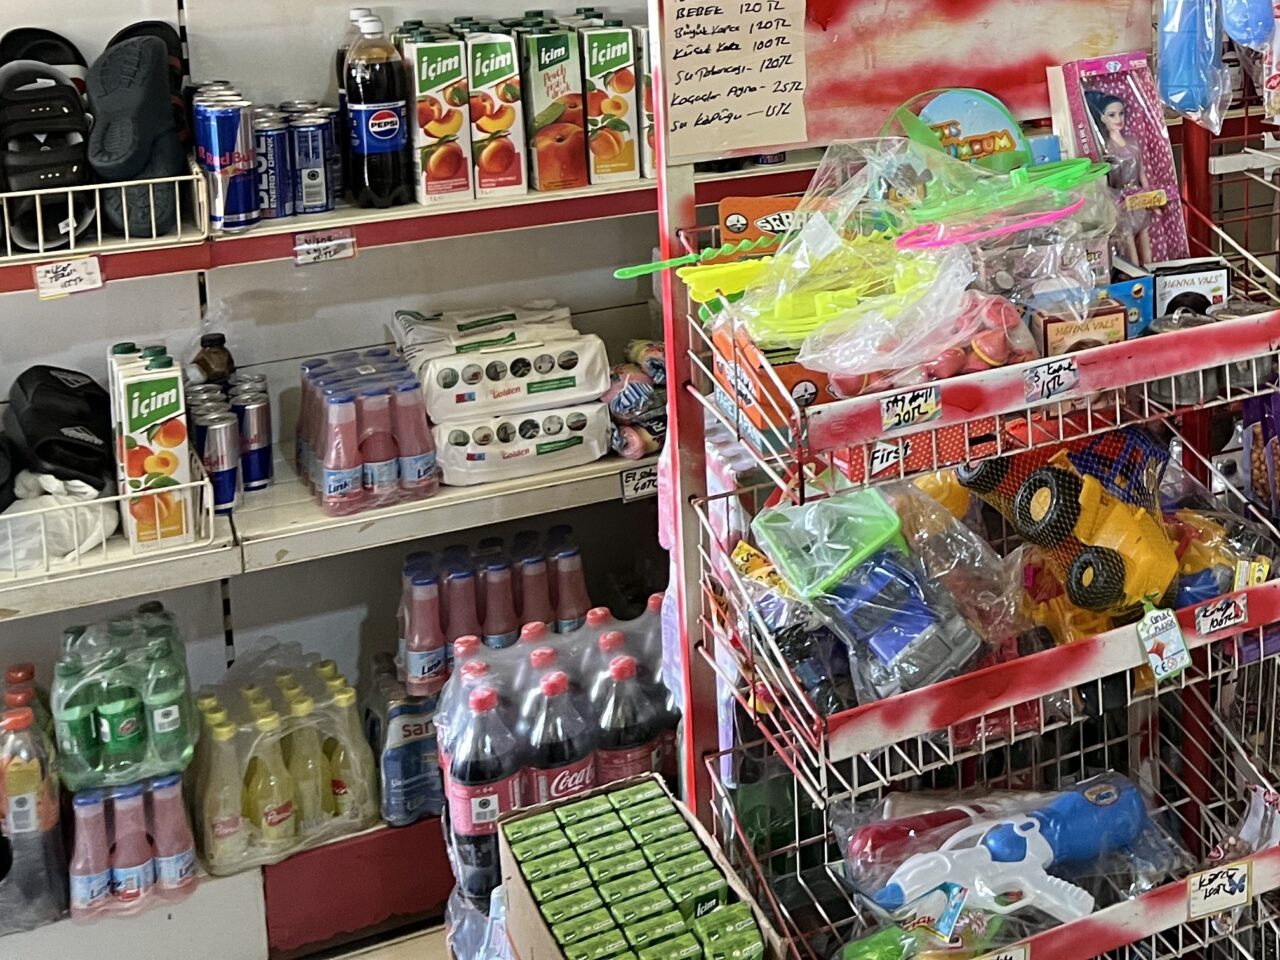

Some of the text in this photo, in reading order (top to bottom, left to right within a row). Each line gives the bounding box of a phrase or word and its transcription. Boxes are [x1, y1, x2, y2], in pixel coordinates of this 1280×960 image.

[675, 5, 725, 21] BEBEK
[370, 120, 398, 129] PEPSI
[268, 136, 277, 209] ENERGY DRINK
[870, 441, 913, 469] First
